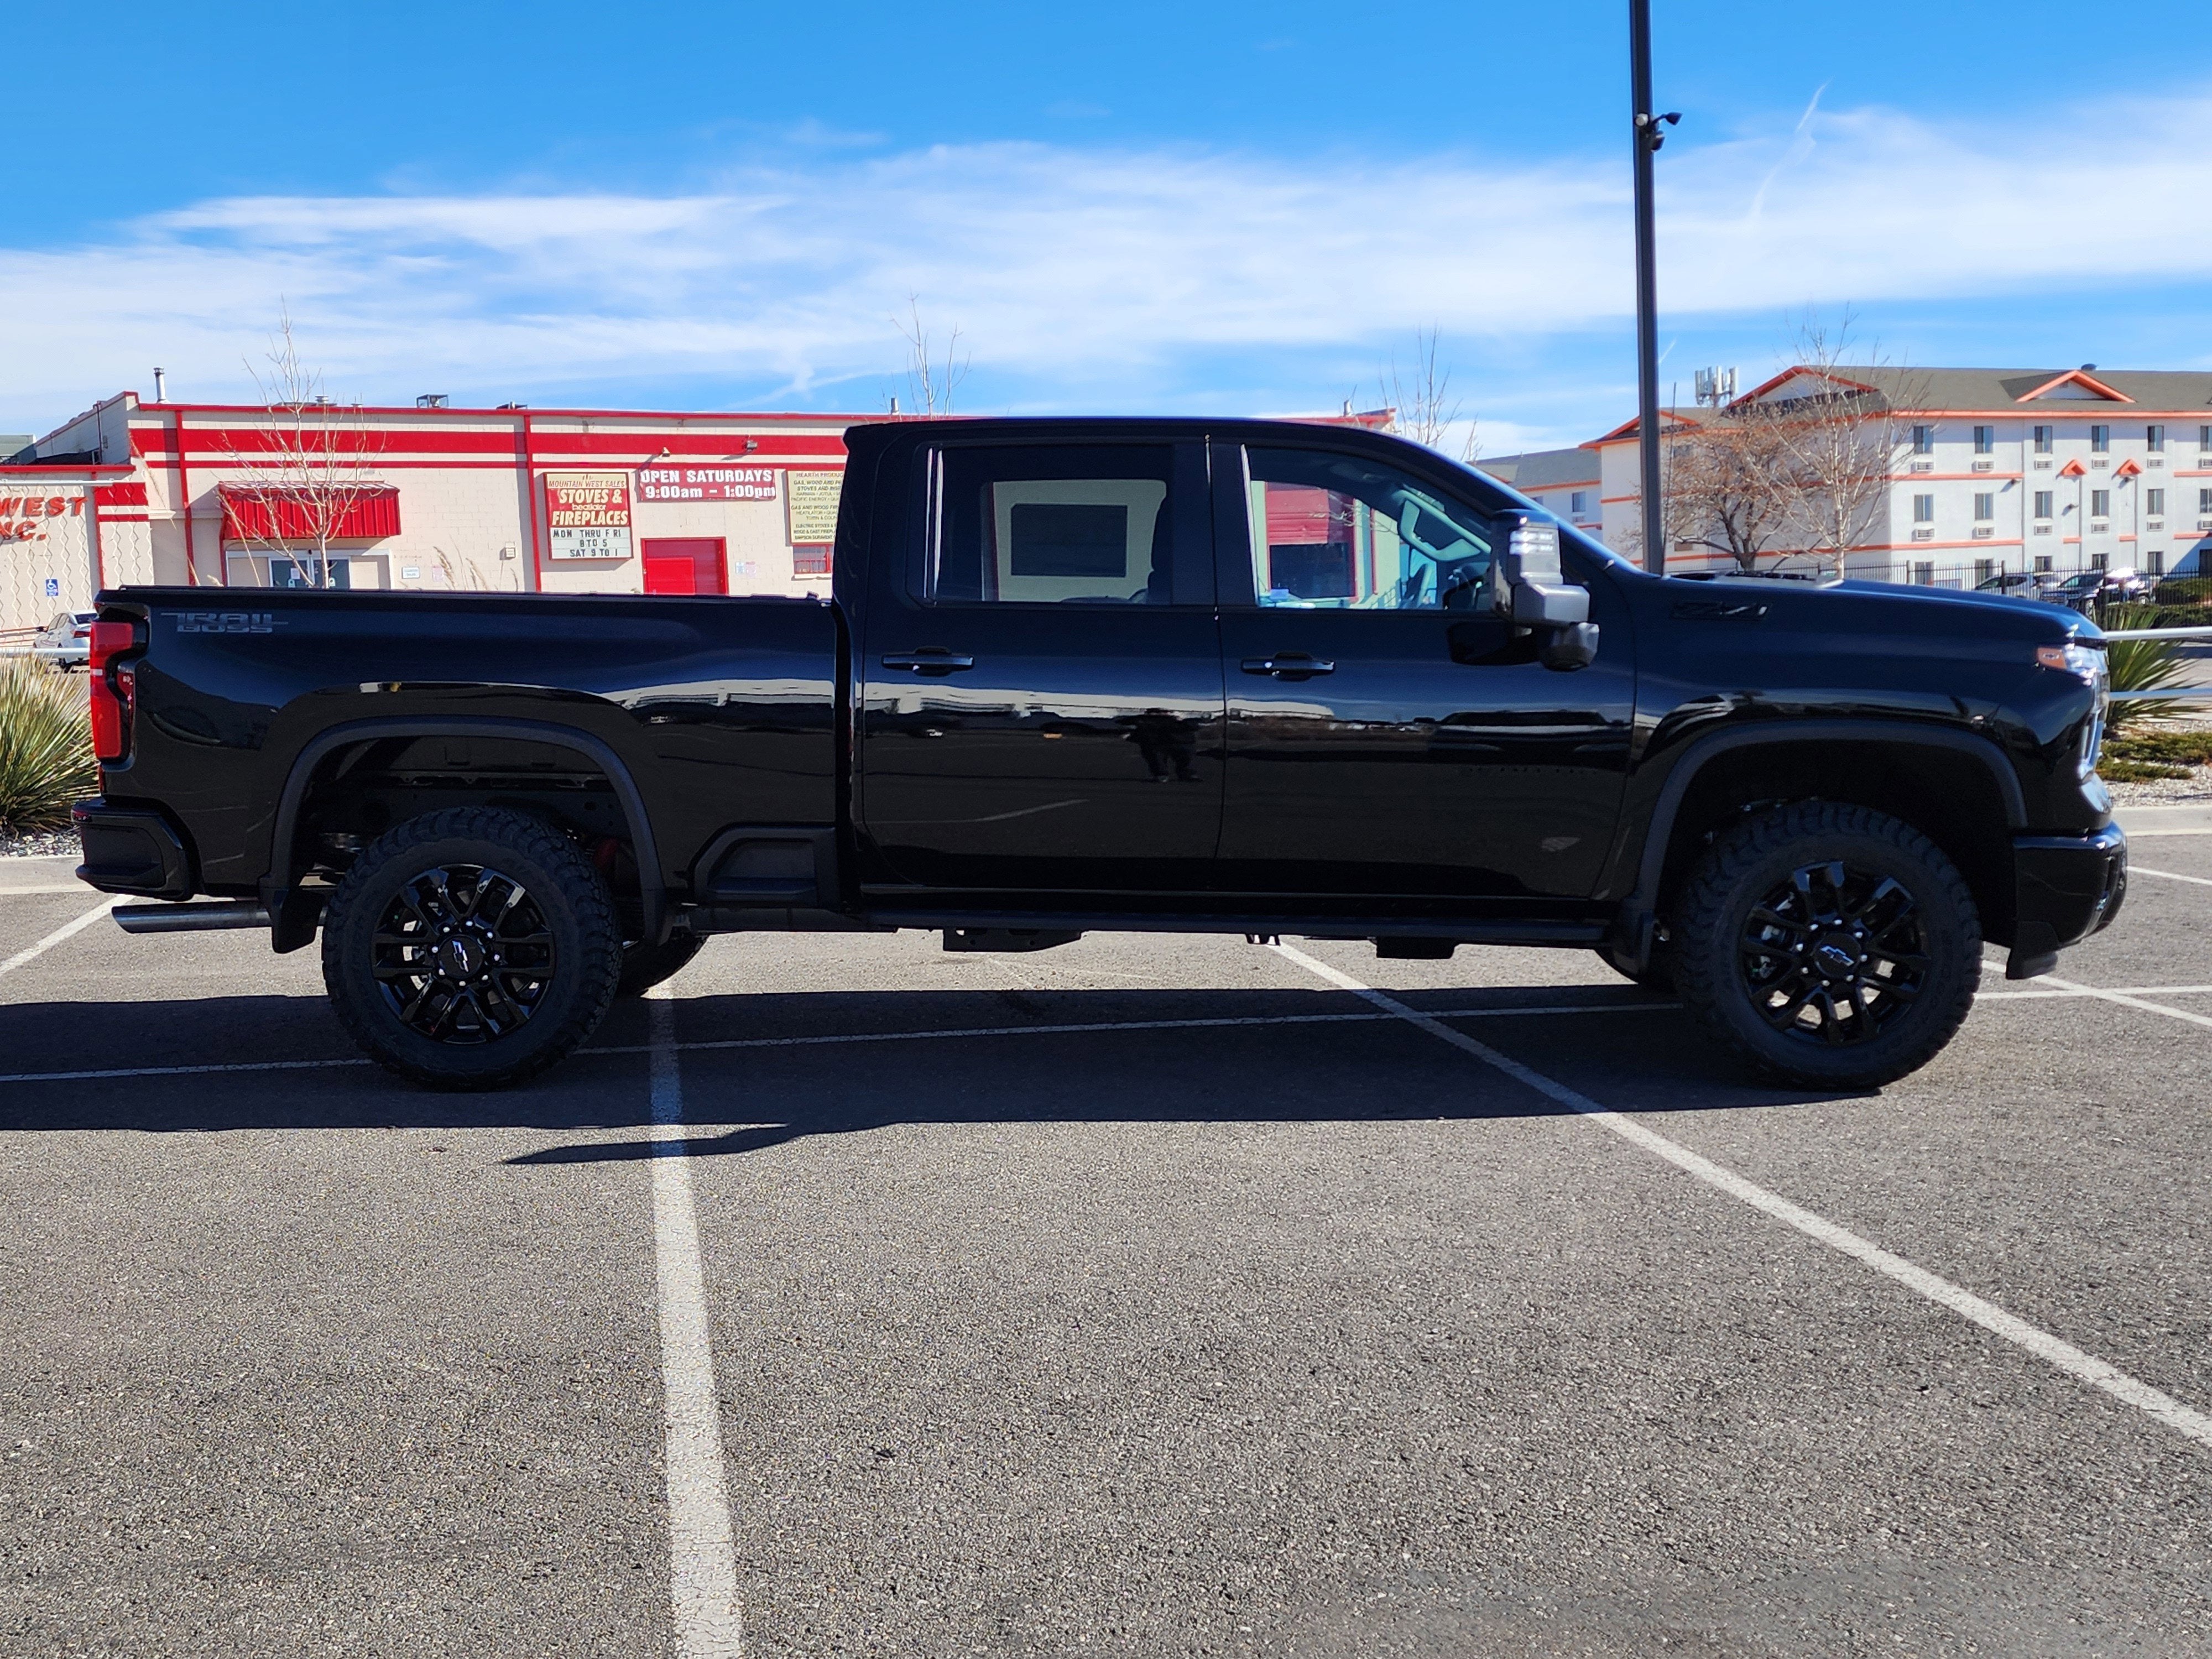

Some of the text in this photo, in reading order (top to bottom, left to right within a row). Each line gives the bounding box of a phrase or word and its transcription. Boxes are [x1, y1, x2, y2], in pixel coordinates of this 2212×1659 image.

[640, 469, 772, 483] OPEN SATURDAYS
[559, 489, 623, 504] STOVES &
[645, 486, 703, 498] 9:00am
[724, 485, 776, 498] 1:00pm
[0, 497, 88, 517] WEST
[552, 510, 628, 525] FIREPLACES
[0, 521, 46, 541] NC.
[553, 529, 572, 538] MON
[580, 529, 601, 538] THRU
